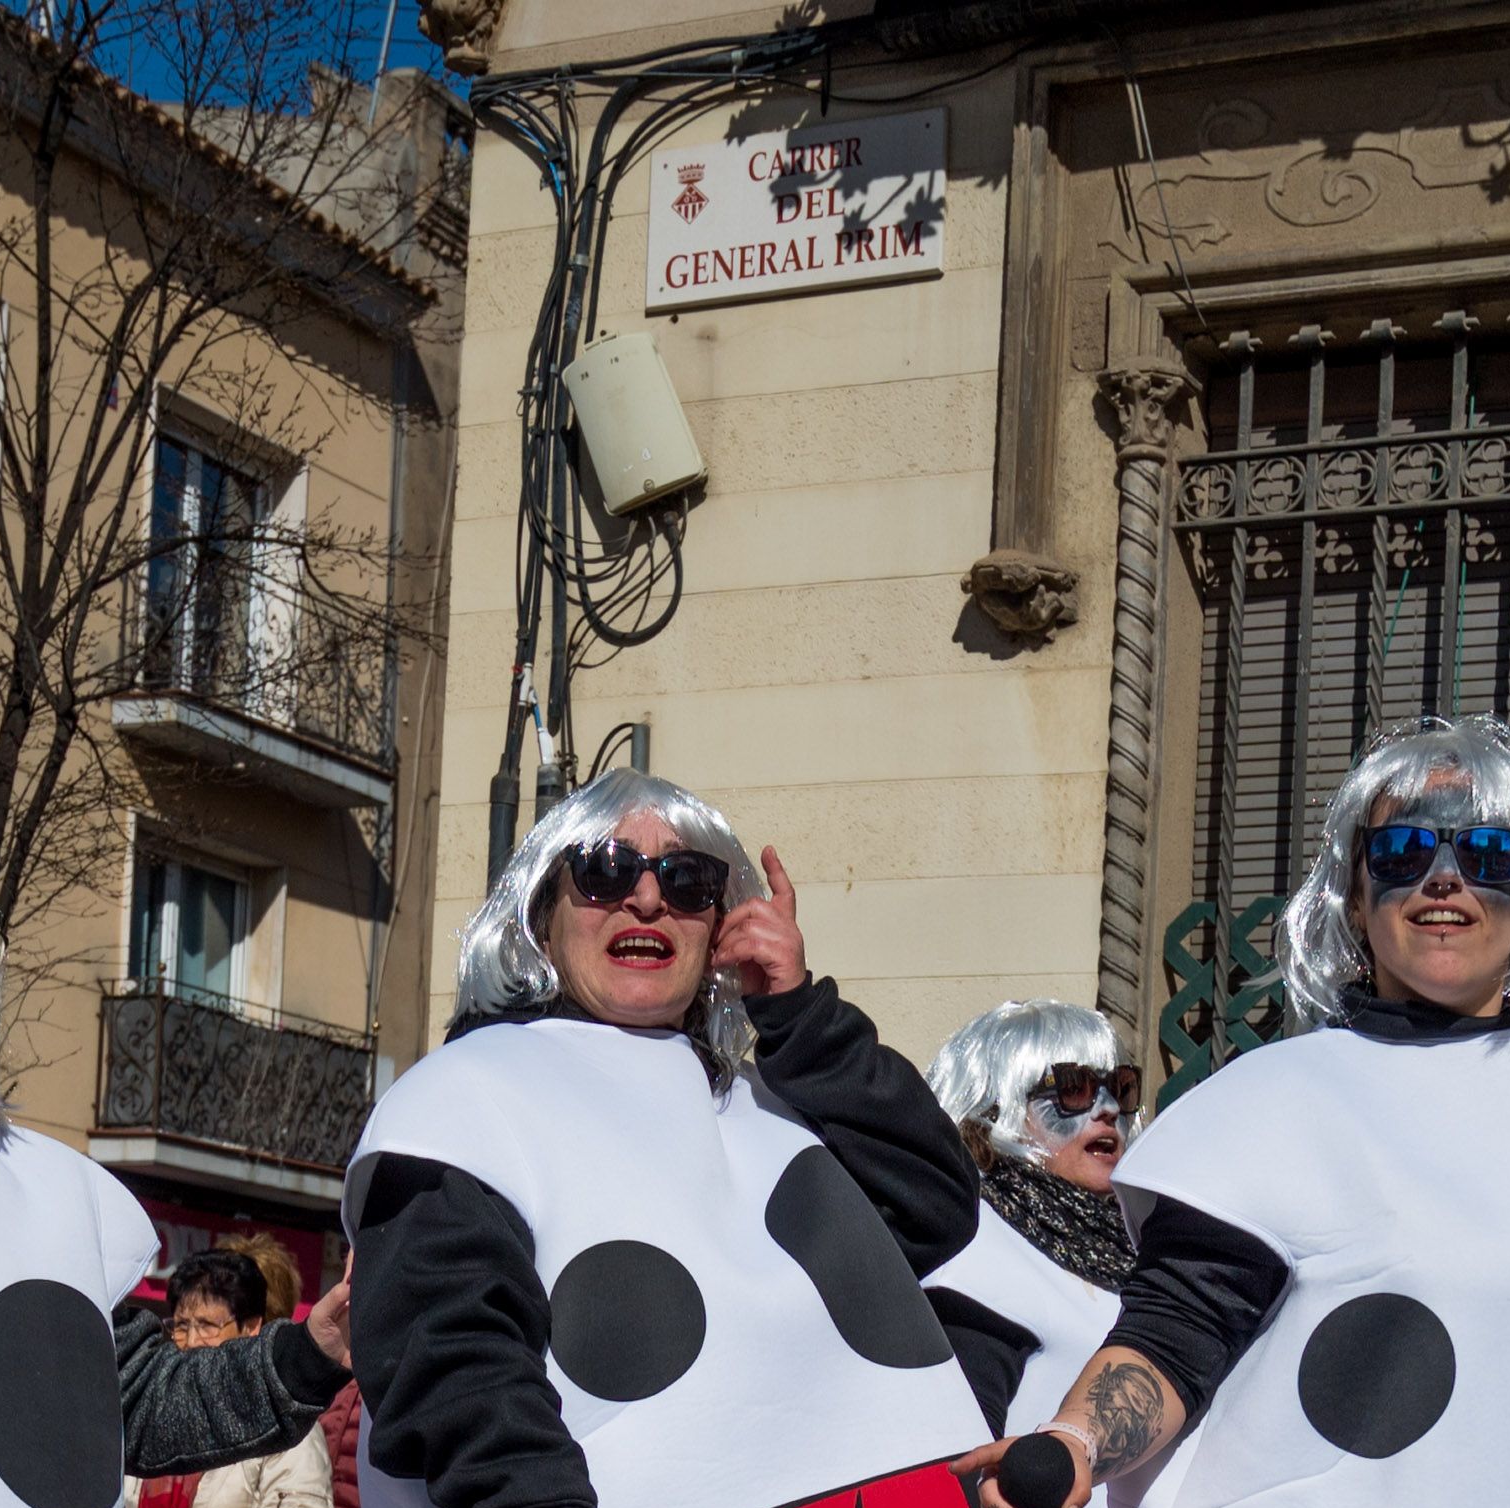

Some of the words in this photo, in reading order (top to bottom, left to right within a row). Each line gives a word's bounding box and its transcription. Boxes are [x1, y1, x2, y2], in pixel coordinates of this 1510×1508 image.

[748, 137, 862, 182] CARRER
[776, 187, 845, 224] DEL
[665, 235, 824, 289] GENERAL
[834, 220, 925, 267] PRIM
